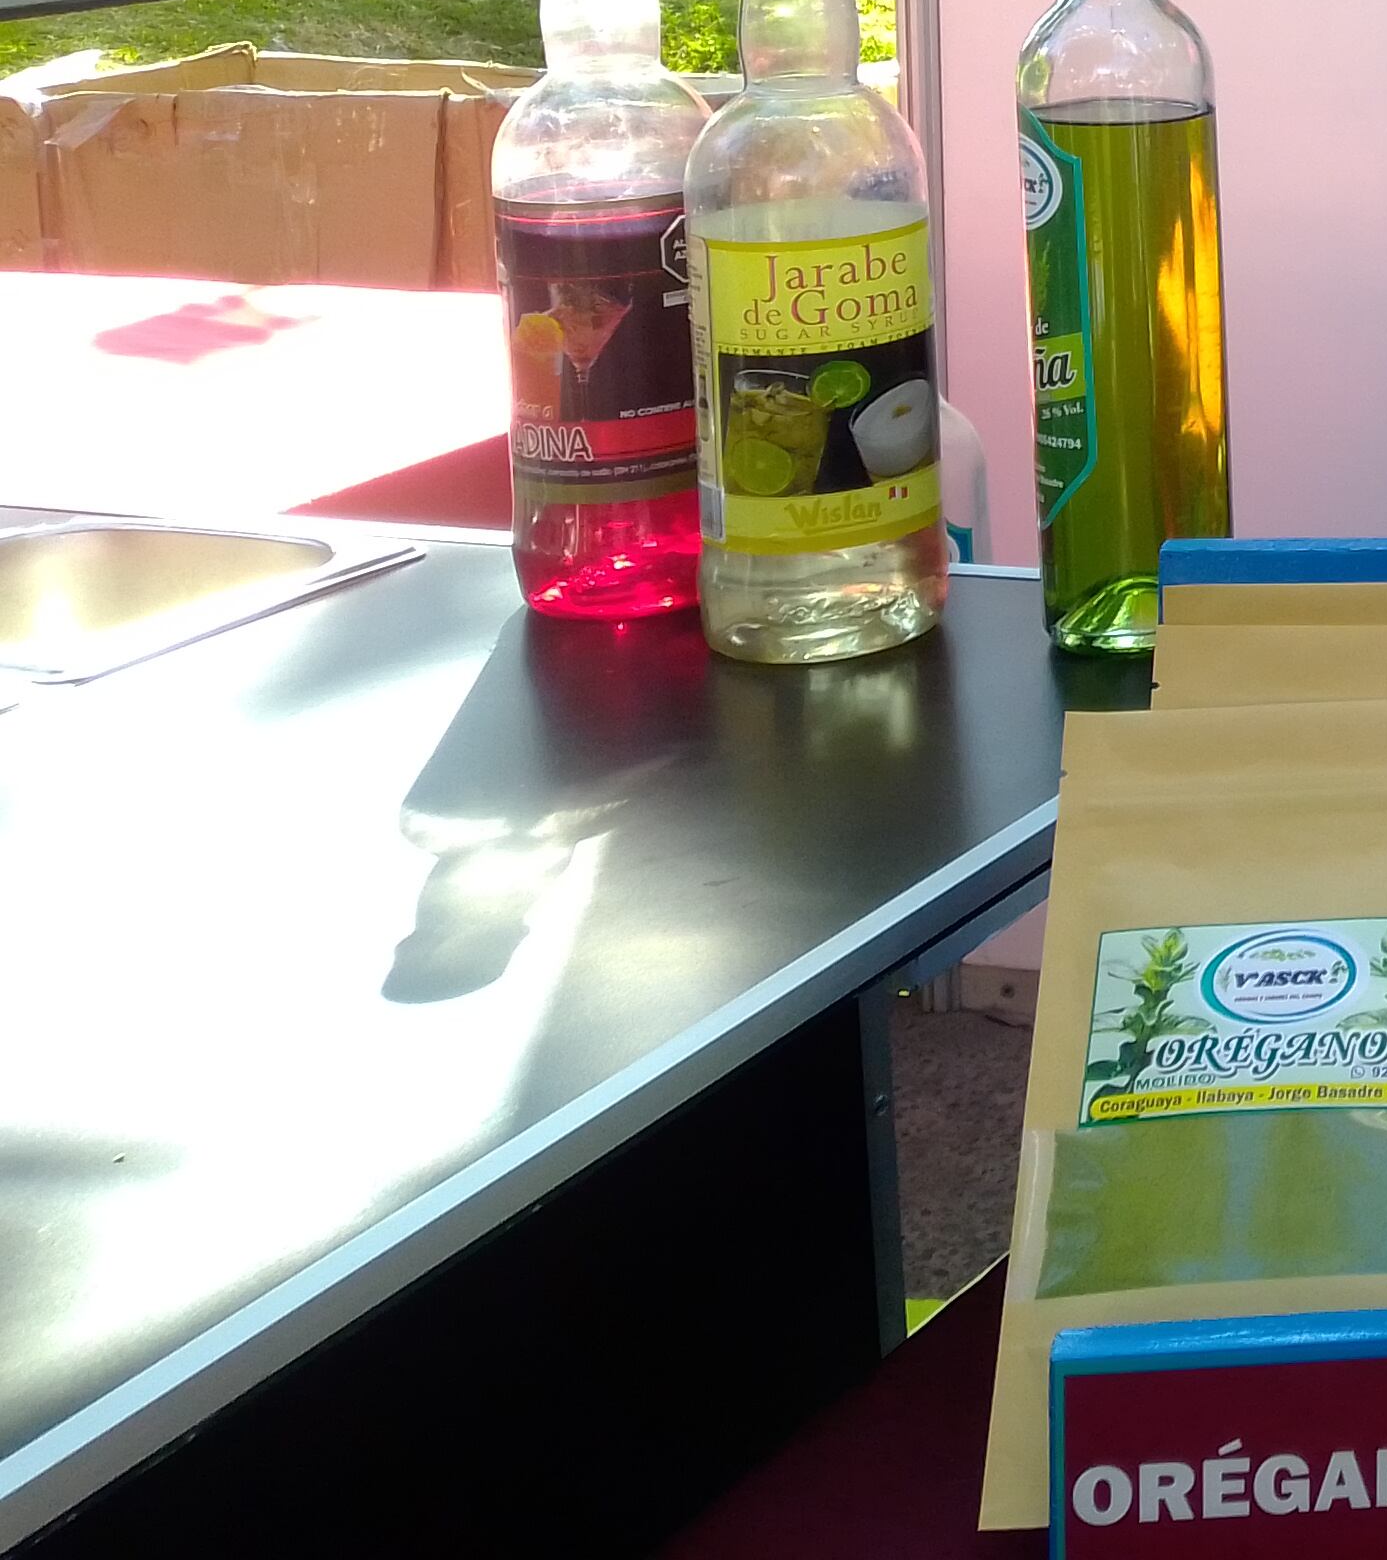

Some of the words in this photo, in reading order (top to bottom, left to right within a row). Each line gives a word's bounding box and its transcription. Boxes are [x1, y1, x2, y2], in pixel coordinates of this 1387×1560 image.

[762, 244, 908, 303] Jarabe
[740, 325, 831, 341] SUGAR
[851, 307, 921, 333] SYRUP
[743, 298, 782, 327] de
[790, 284, 918, 327] Goma
[1035, 317, 1049, 336] de
[513, 420, 594, 462] ADINA
[1099, 1093, 1183, 1115] Coraguaya
[1196, 1088, 1254, 1106] Ilabaya
[1267, 1085, 1312, 1102] Jorge
[1316, 1083, 1384, 1100] Basadre
